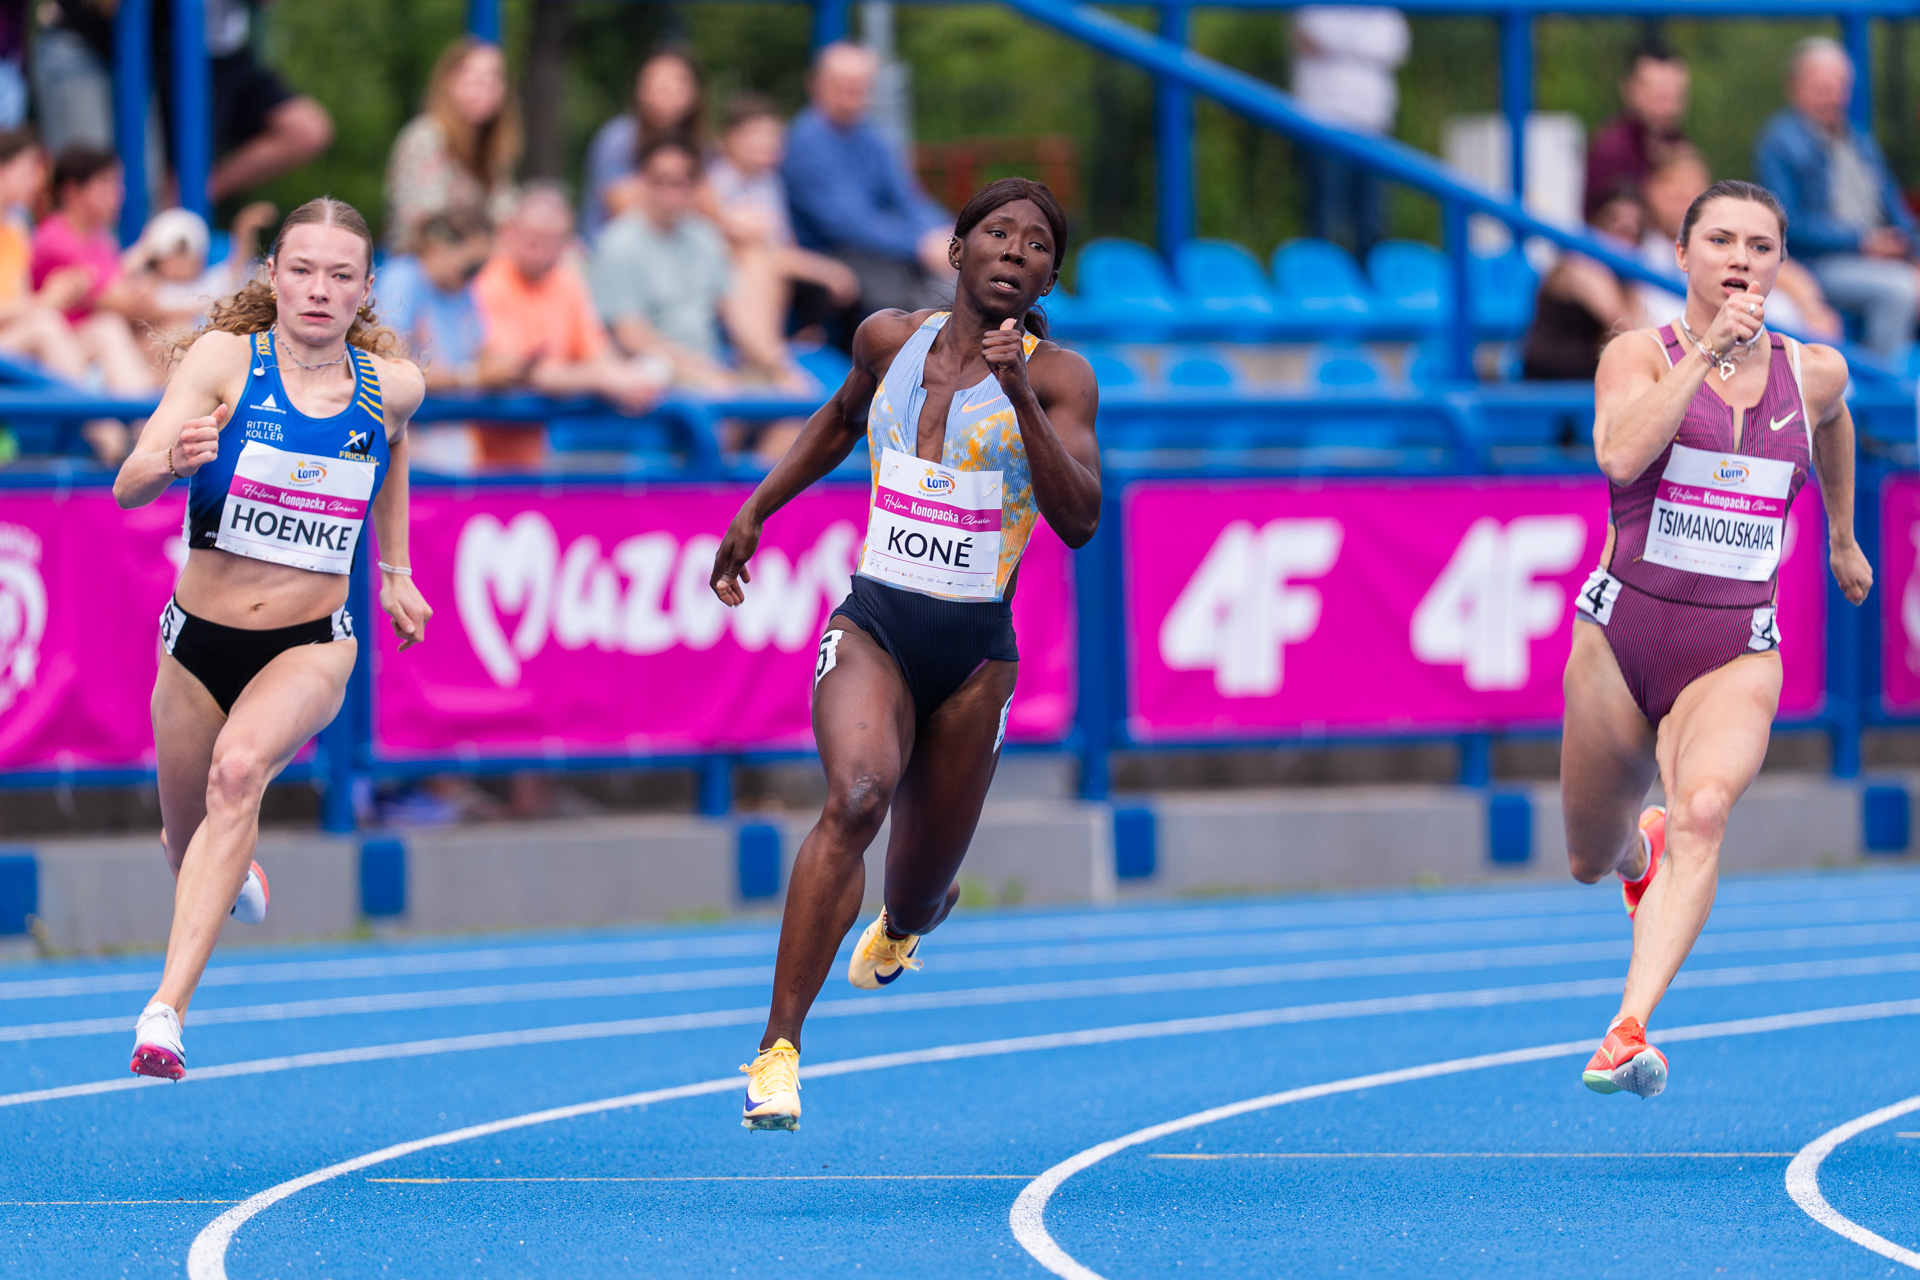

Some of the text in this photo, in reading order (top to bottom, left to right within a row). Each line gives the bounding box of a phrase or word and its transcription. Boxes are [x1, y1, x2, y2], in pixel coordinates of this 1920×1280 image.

[245, 429, 284, 442] KOLLER
[247, 420, 282, 432] RITTER
[297, 469, 320, 479] LOTTO
[926, 477, 950, 489] LOTTO
[1720, 468, 1744, 479] LOTTO
[242, 483, 358, 513] Halina Konopacka Classic
[883, 493, 991, 526] Halina Konopacka Classic
[1667, 486, 1778, 512] Halina Konopacka Classic
[230, 503, 353, 552] HOENKE
[1657, 507, 1775, 551] TSIMANOUSKAYA
[887, 525, 974, 568] KONÉ
[1158, 515, 1346, 698] 4F
[1409, 514, 1588, 692] 4F
[1586, 578, 1610, 614] 4
[162, 603, 175, 643] 6
[816, 634, 833, 678] 5
